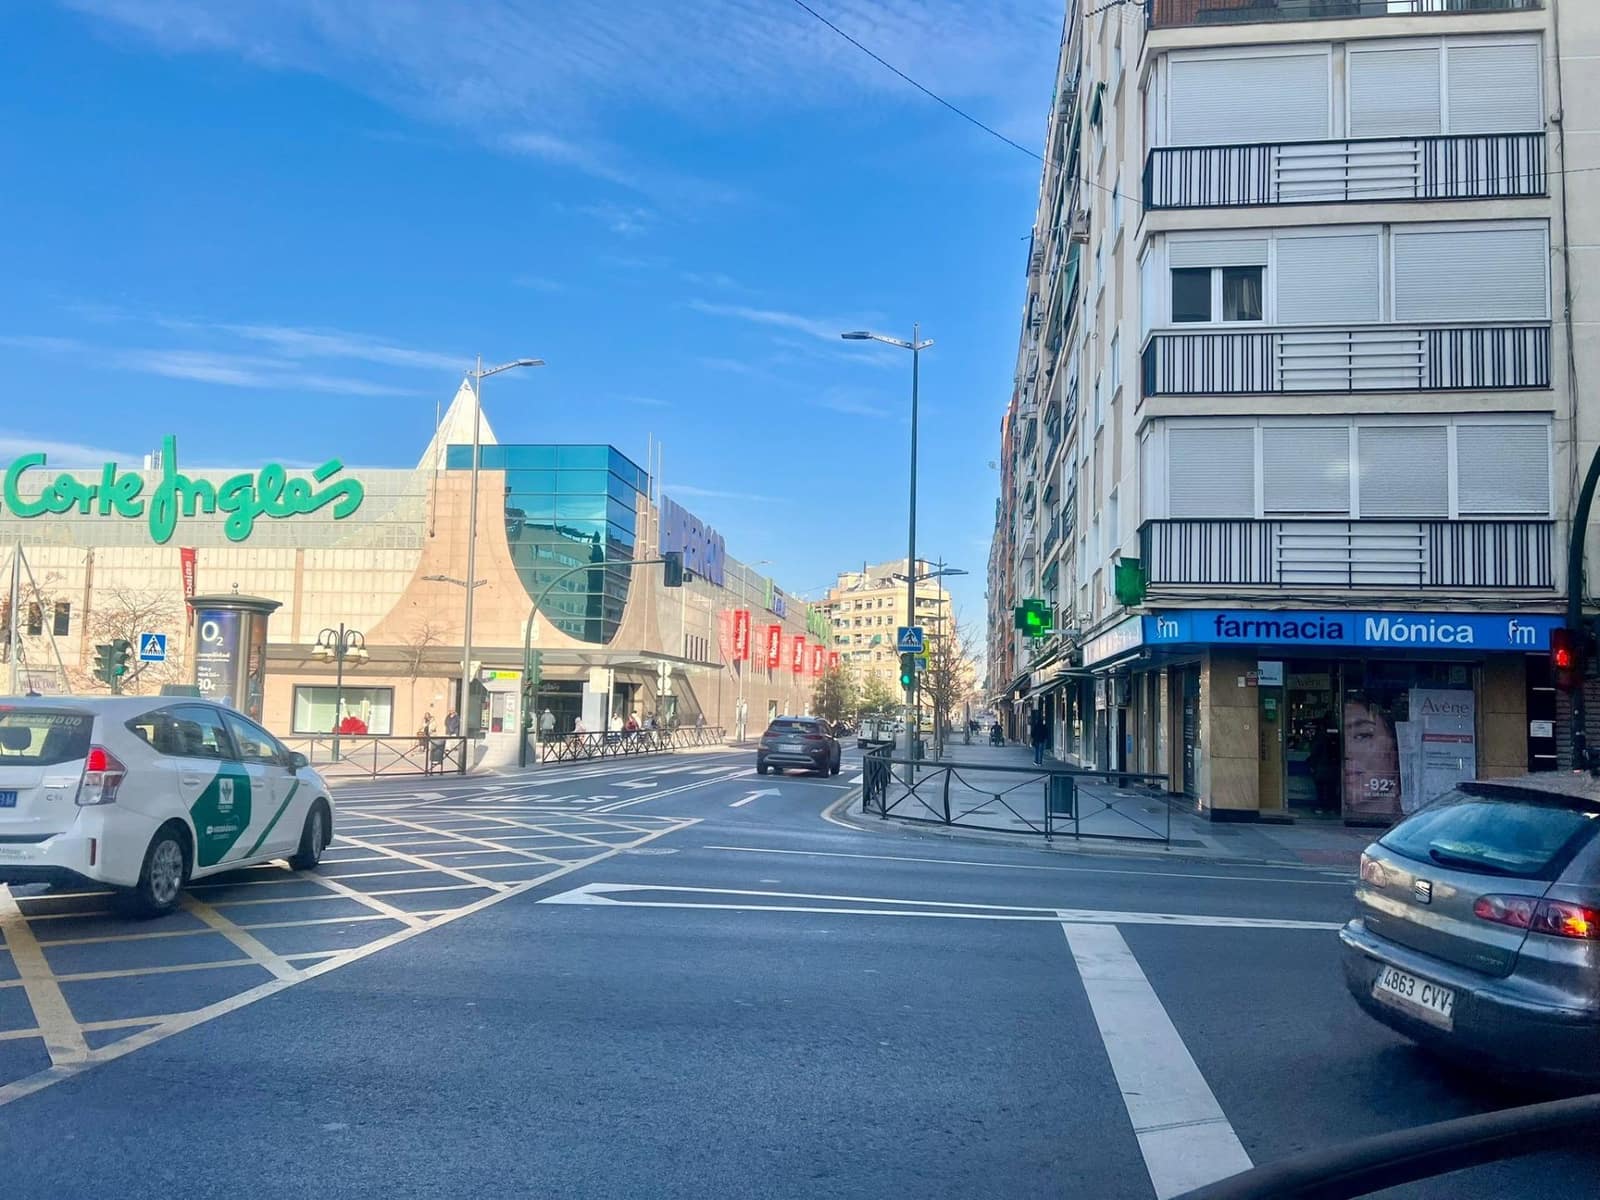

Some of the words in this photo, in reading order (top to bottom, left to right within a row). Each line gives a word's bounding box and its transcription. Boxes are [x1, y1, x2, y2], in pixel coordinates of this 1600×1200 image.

[4, 452, 144, 518] Corte
[149, 434, 364, 544] Inglés
[202, 621, 224, 646] O2
[1214, 614, 1344, 640] farmacia
[1365, 617, 1473, 643] Mónica
[1421, 697, 1470, 713] Avène
[1384, 969, 1415, 996] 4863
